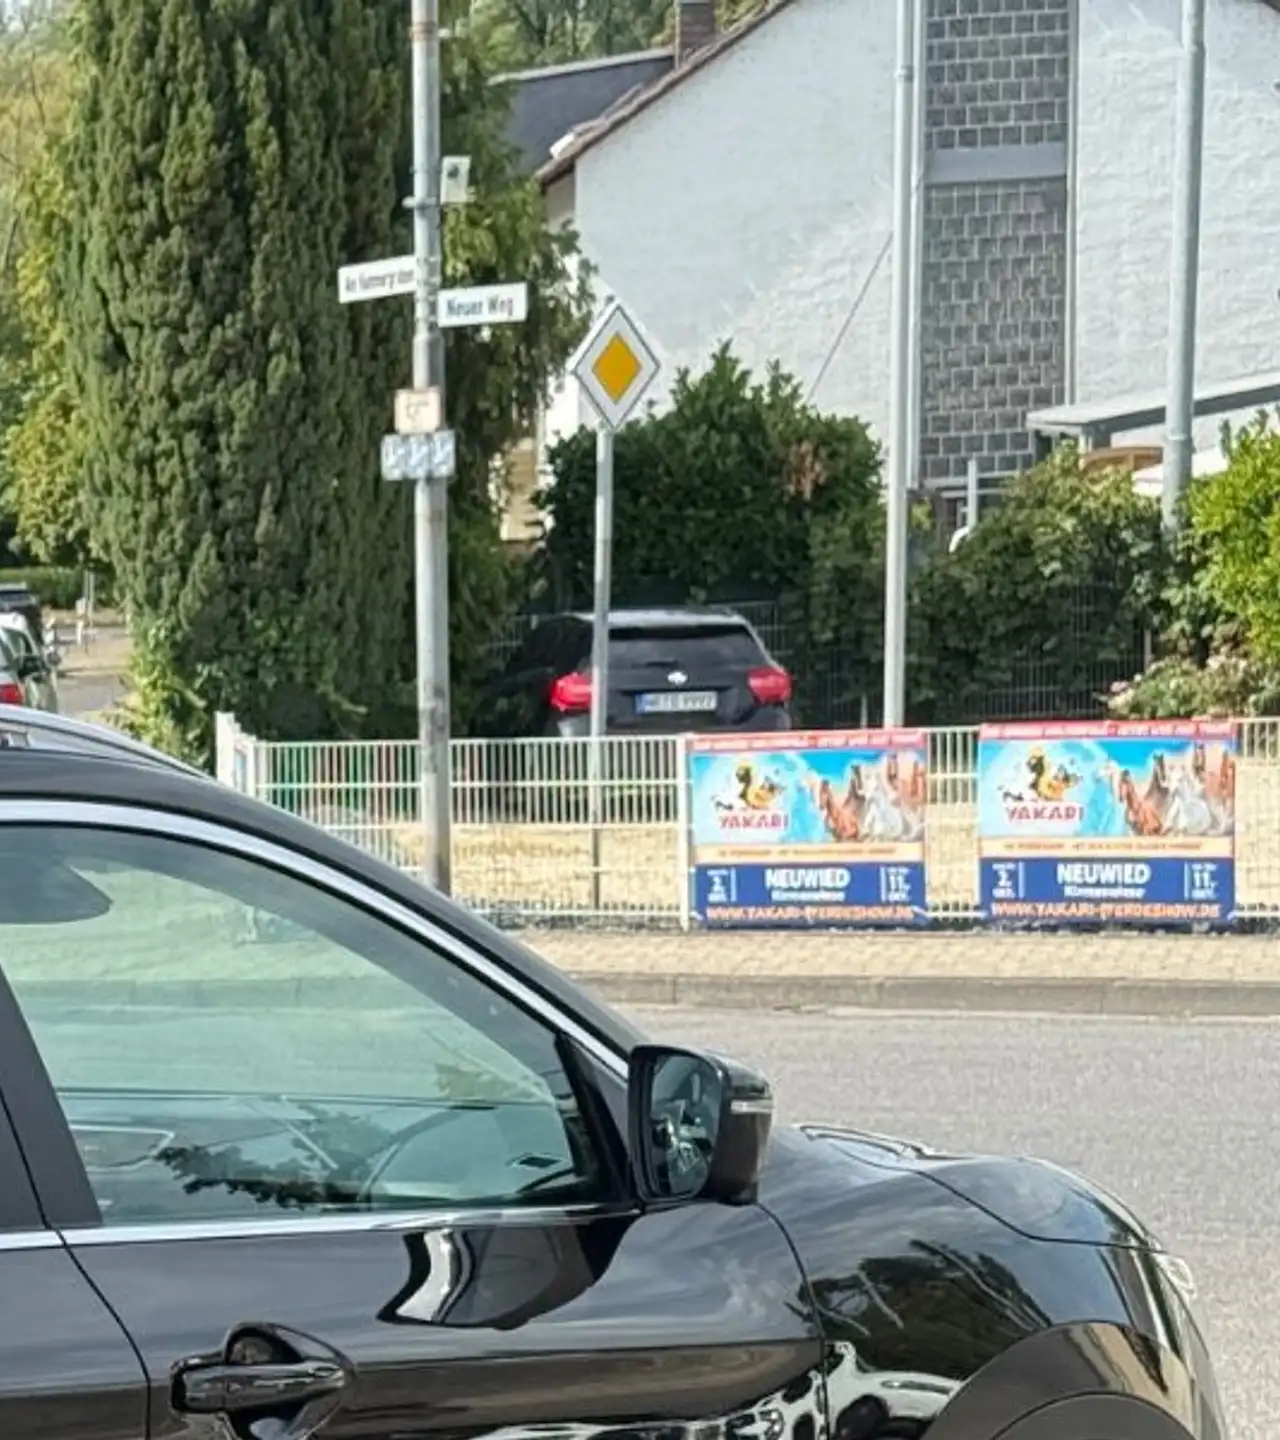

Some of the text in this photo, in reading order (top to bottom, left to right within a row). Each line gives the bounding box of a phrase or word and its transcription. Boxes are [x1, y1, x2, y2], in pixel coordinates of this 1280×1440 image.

[488, 296, 513, 317] Weg
[765, 868, 851, 889] NEUWIED
[1057, 863, 1151, 885] NEUWIED
